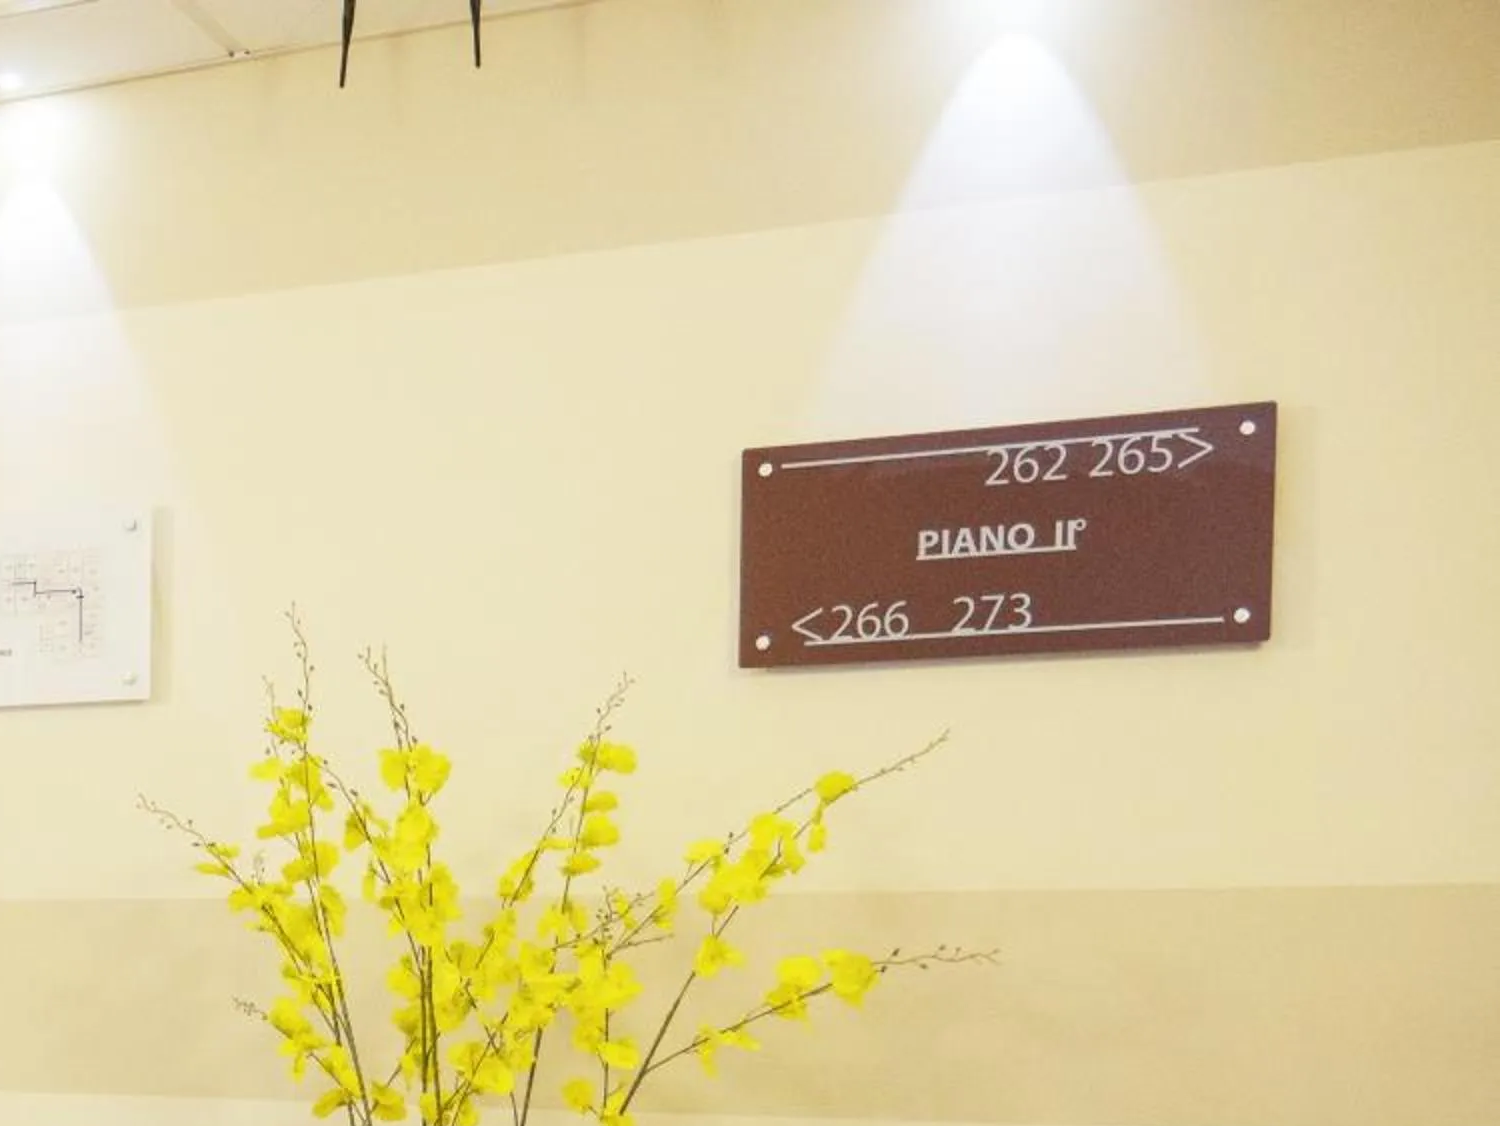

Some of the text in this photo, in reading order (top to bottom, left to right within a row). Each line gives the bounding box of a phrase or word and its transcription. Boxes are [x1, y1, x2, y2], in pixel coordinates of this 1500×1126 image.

[985, 434, 1174, 486] 262 265
[918, 523, 1035, 557] PIANO
[830, 592, 1033, 642] 266 273
